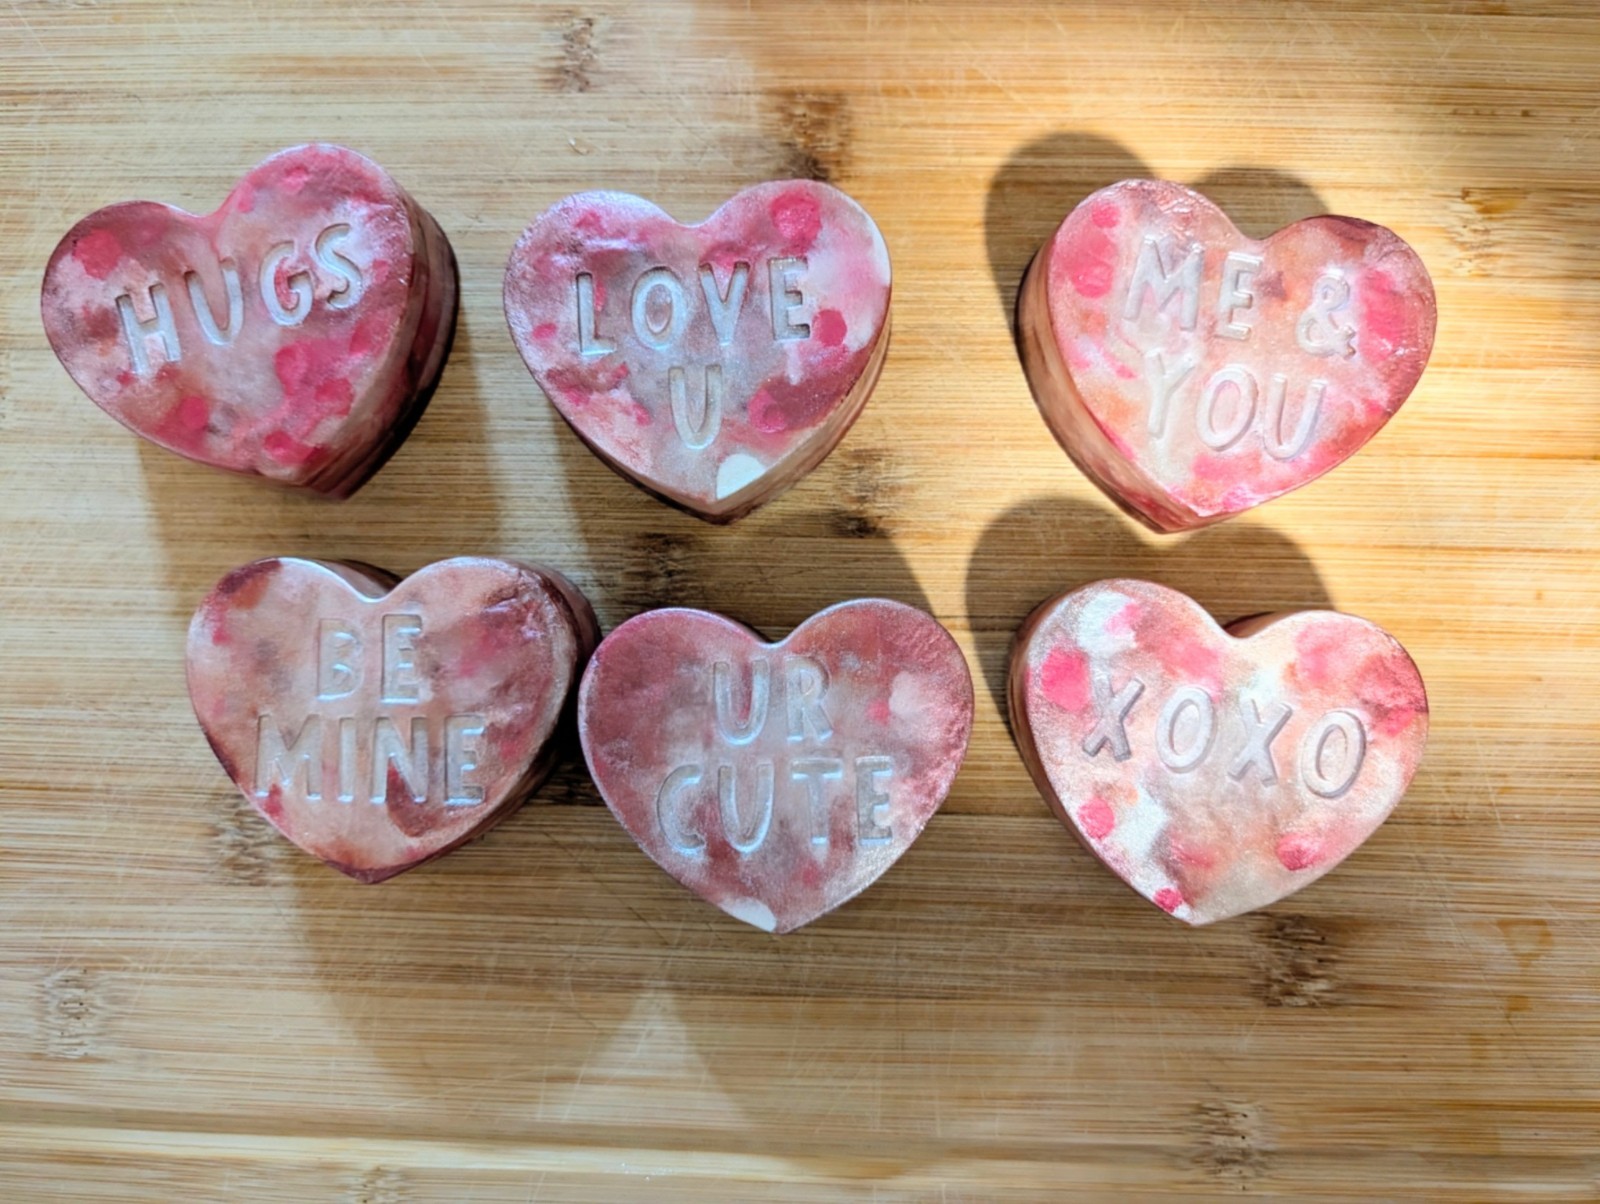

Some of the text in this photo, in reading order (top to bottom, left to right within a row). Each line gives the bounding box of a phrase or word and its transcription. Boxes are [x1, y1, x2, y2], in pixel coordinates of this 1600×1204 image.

[115, 222, 363, 374] HUGS
[575, 257, 811, 355] LOVE
[1122, 235, 1357, 358] ME &
[670, 366, 724, 449] U
[1147, 348, 1327, 461] YOU
[317, 613, 423, 705] BE
[713, 656, 834, 746] UR
[256, 713, 486, 806] MINE
[1082, 675, 1368, 799] XOXO
[656, 757, 894, 855] CUTE
